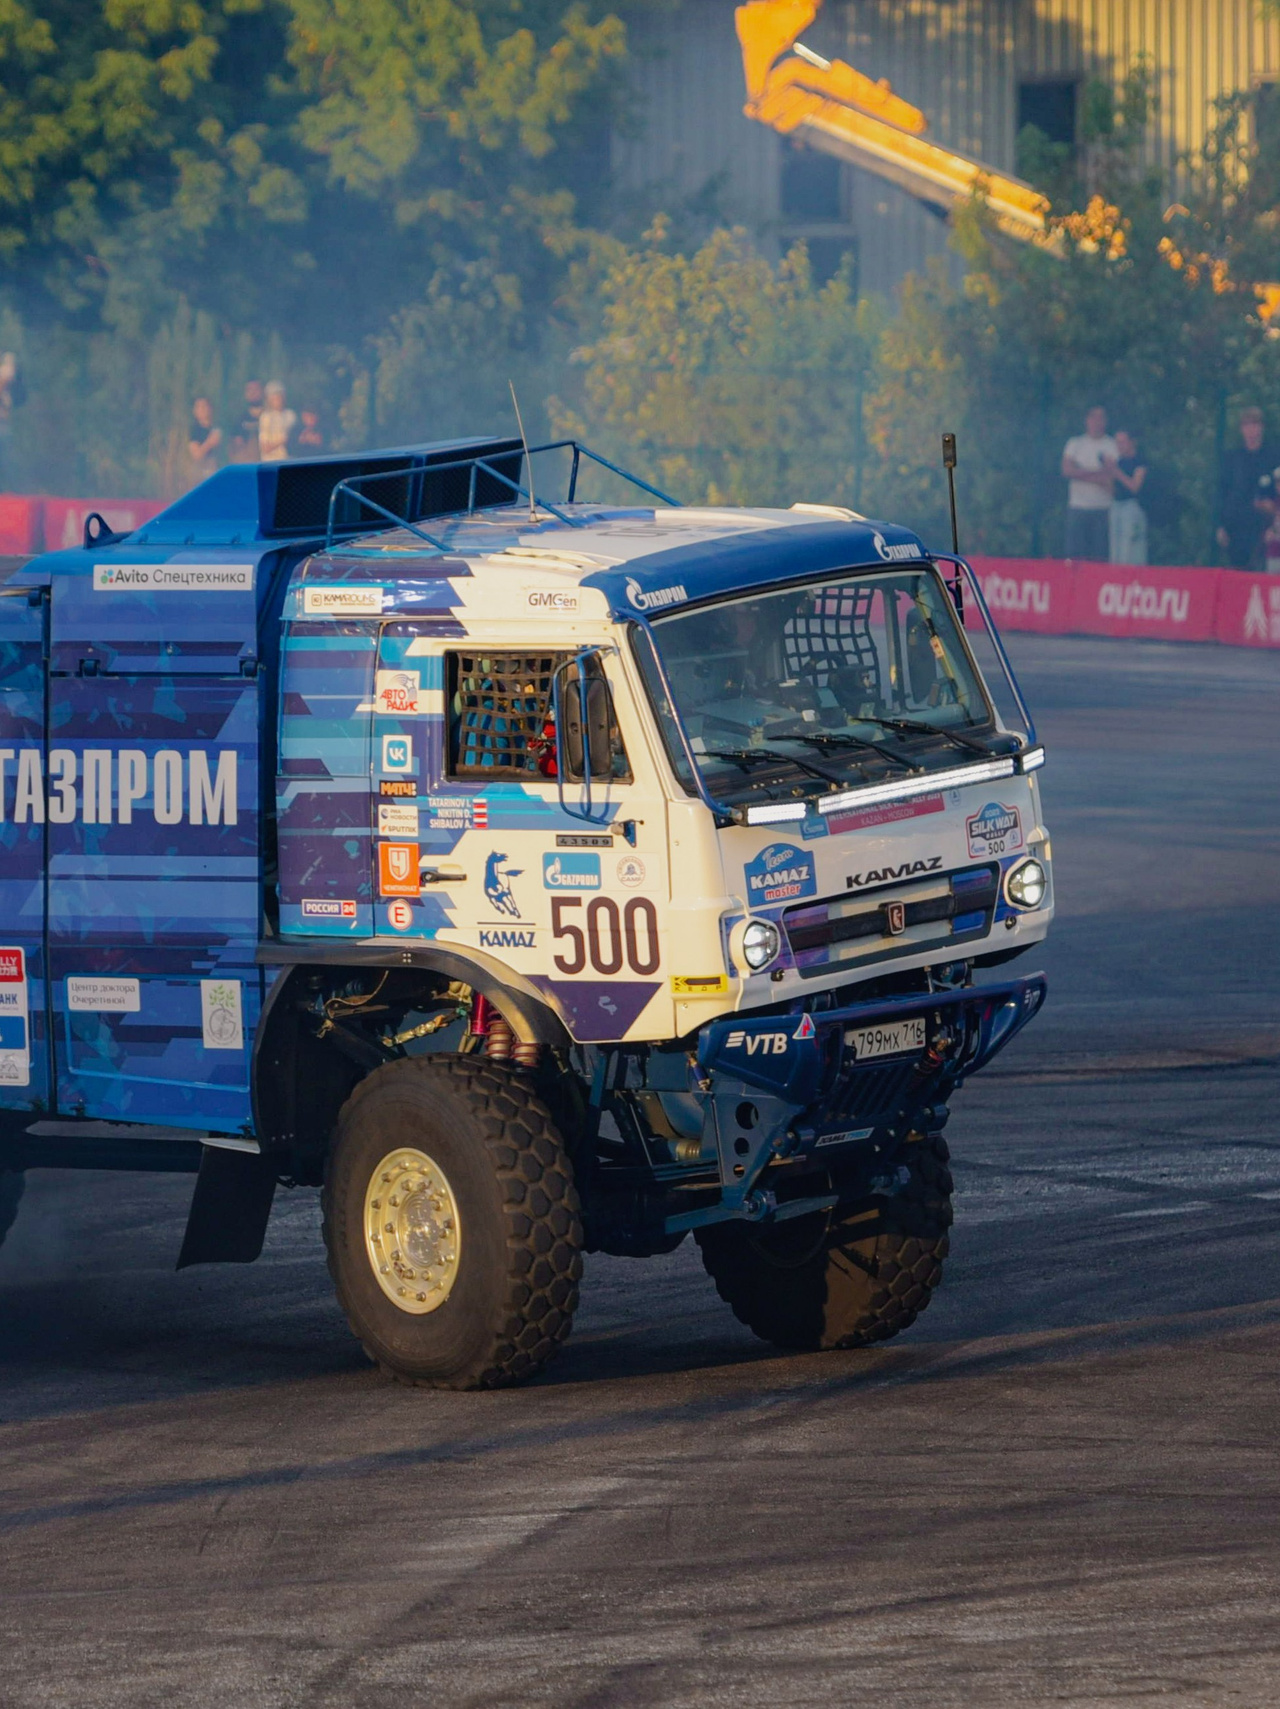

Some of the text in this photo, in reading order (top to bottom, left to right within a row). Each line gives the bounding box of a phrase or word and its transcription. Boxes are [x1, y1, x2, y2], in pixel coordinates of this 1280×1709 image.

[114, 569, 246, 585] Avito Спецтехника
[646, 585, 688, 608] ГАЗПРОМ
[1098, 580, 1190, 621] auto.ru
[380, 689, 406, 700] АВТО
[389, 748, 405, 760] VK
[381, 782, 417, 795] МАТЧ!
[428, 798, 465, 807] TATARINOV
[430, 819, 463, 829] SHIBALOV
[971, 814, 1016, 836] SILK WAY
[560, 838, 610, 846] 43509
[988, 840, 1006, 856] 500
[762, 847, 794, 871] Team
[561, 874, 599, 886] GAZPROM
[750, 866, 810, 889] KAMAZ
[846, 856, 943, 889] KAMAZ
[765, 884, 801, 901] master
[306, 903, 354, 913] РОССИЯ 24
[479, 930, 538, 948] KAMAZ
[551, 896, 661, 976] 500
[71, 983, 136, 994] Центр доктора
[746, 1033, 788, 1055] VTB
